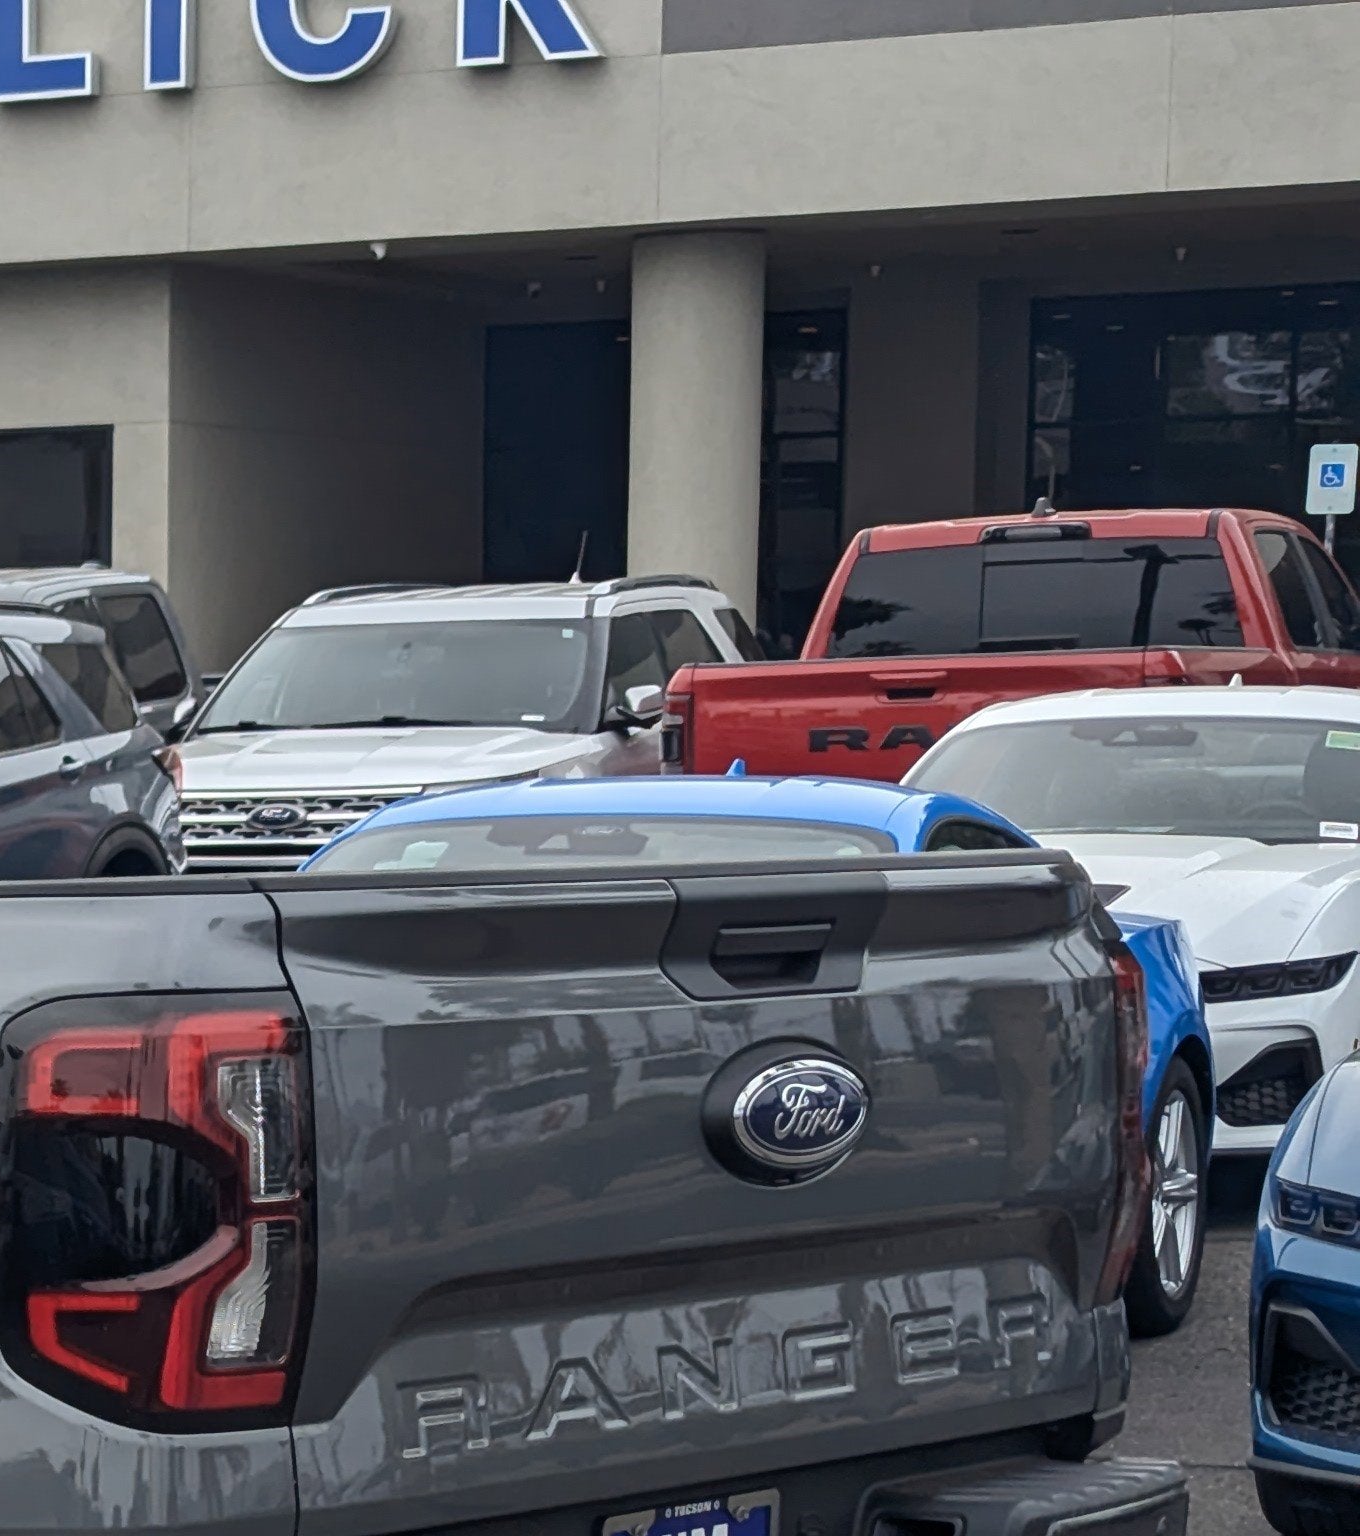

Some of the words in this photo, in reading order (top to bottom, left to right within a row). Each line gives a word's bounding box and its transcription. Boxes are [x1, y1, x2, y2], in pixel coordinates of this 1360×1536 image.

[809, 724, 954, 752] RA
[774, 1083, 847, 1140] Ford
[394, 1293, 1056, 1460] RANGER
[674, 1501, 712, 1517] TUCSON
